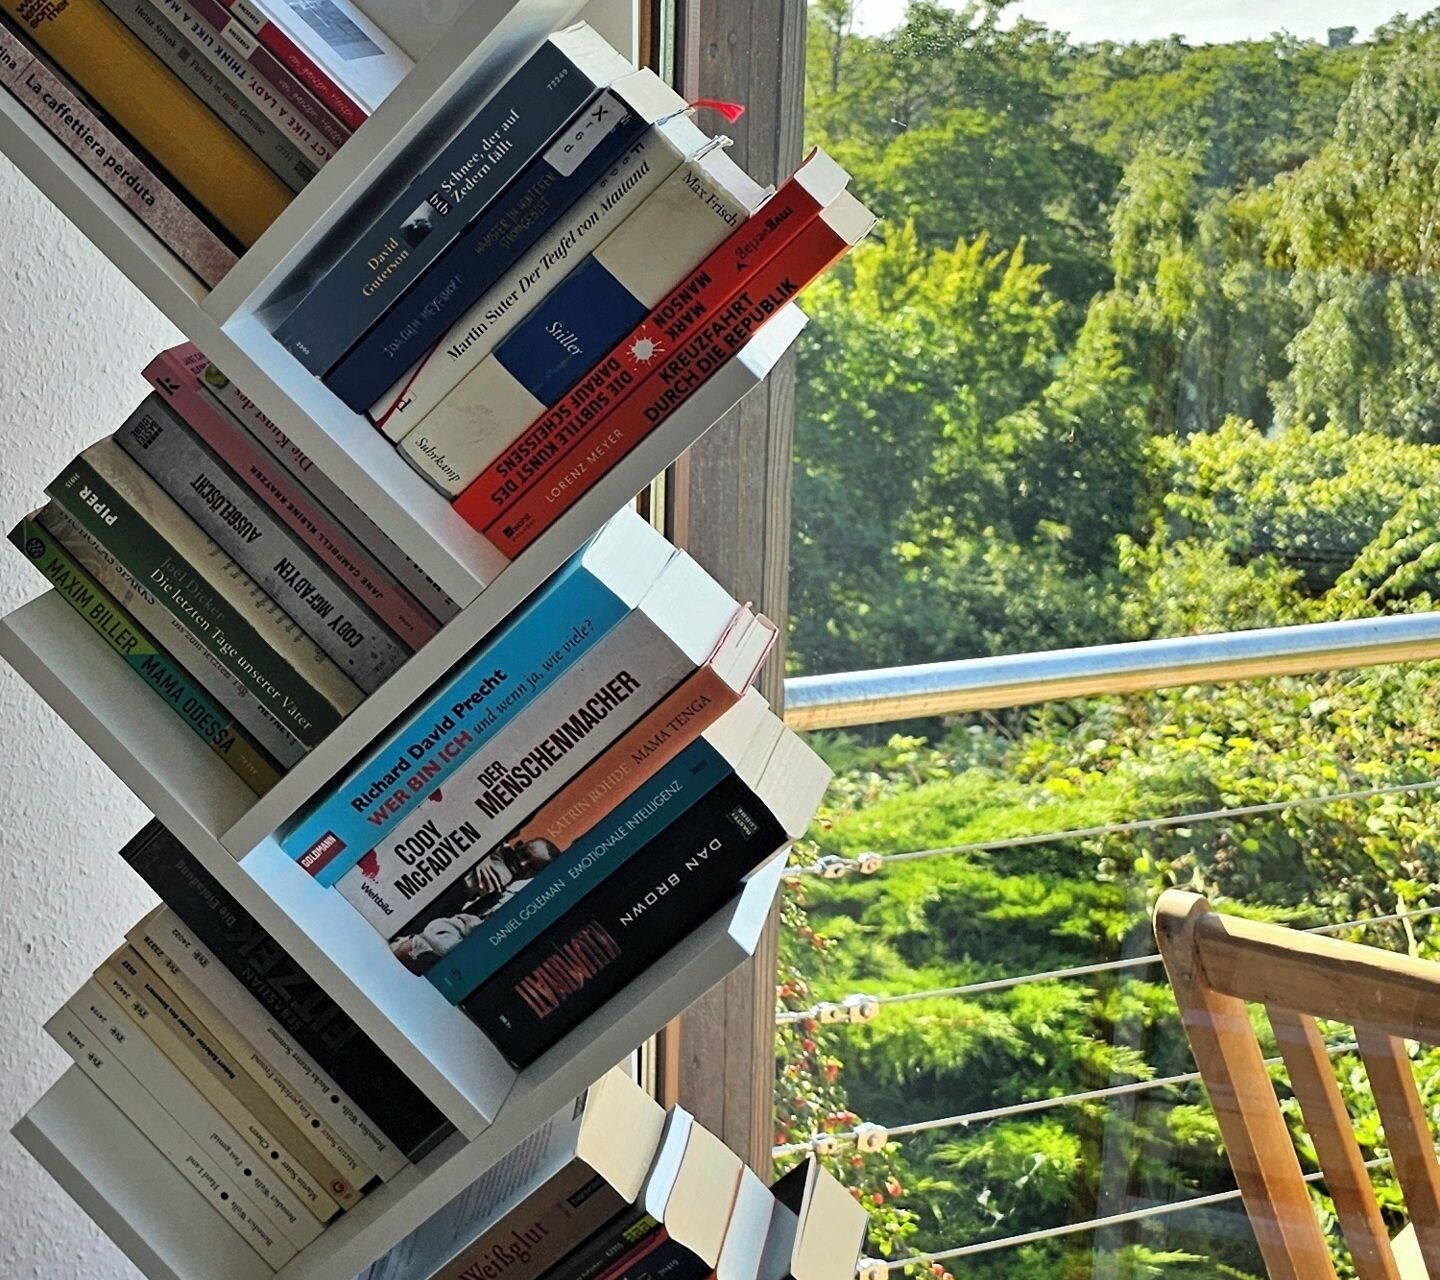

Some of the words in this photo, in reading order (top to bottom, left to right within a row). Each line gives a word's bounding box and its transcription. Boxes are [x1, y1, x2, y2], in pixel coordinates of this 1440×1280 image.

[188, 19, 216, 47] LIKE
[212, 43, 249, 80] THINK
[243, 73, 279, 109] LADY,
[23, 72, 46, 96] La
[39, 88, 111, 160] caffettiera
[102, 152, 160, 210] perduta
[285, 115, 313, 143] LIKE
[438, 147, 486, 196] Schnee,
[479, 127, 504, 152] der
[496, 106, 523, 133] auf
[449, 160, 492, 204] Zedern
[485, 135, 515, 166] fällt
[681, 170, 711, 200] Max
[704, 193, 740, 228] Frisch
[359, 246, 411, 299] Guterson
[365, 236, 401, 272] David
[445, 318, 489, 363] Martin
[483, 286, 522, 326] Suter
[515, 262, 546, 294] Der
[538, 229, 580, 273] Teufel
[575, 209, 602, 236] von
[650, 268, 712, 331] MANSON
[542, 317, 587, 361] Stiller
[642, 370, 696, 425] DURCH
[688, 343, 724, 380] DIE
[717, 272, 798, 355] REPUBLIK
[657, 287, 756, 388] KREUZFAHRT
[662, 297, 707, 343] MARK
[566, 353, 623, 411] DARAUF
[604, 367, 634, 397] DIE
[493, 400, 574, 482] SCHEISSENS
[554, 388, 611, 447] SUBTILE
[412, 434, 464, 485] Suhrkamp
[513, 437, 561, 486] KUNST
[543, 458, 589, 505] LORENZ
[584, 424, 625, 466] MEYER
[76, 484, 119, 527] PIPER
[489, 476, 520, 508] DES
[43, 557, 95, 610] MAXIM
[87, 602, 140, 654] BILLER
[148, 567, 175, 593] Die
[169, 587, 214, 633] letzten
[207, 626, 242, 661] Tage
[235, 653, 282, 701] unserer
[277, 694, 315, 733] Väter
[138, 655, 188, 705] MAMA
[178, 695, 239, 755] ODESSA
[367, 785, 413, 830] WER
[406, 757, 442, 793] BIN
[436, 727, 475, 766] ICH
[470, 707, 499, 736] und
[495, 682, 528, 715] wenn
[539, 646, 565, 672] wie
[559, 616, 597, 654] viele?
[350, 753, 413, 815] Richard
[407, 713, 457, 762] David
[450, 664, 509, 722] Precht
[475, 663, 641, 825] MENSCHENMACHER
[476, 758, 509, 790] DER
[300, 833, 338, 870] GOLDMANN
[393, 817, 444, 868] CODY
[568, 825, 628, 880] EMOTIONALE
[624, 778, 684, 832] INTELLIGENZ
[682, 835, 723, 873] DAN
[393, 816, 482, 904] McFADYEN
[359, 881, 394, 917] Weltbild
[488, 915, 523, 948] DANIEL
[517, 877, 567, 922] GOLEMAN
[616, 870, 682, 930] BROWN
[510, 916, 623, 1023] ILLUMINATI
[184, 1153, 206, 1175] Land
[201, 1171, 221, 1191] Hard
[228, 1199, 249, 1220] Wells
[245, 1216, 275, 1246] Benedict
